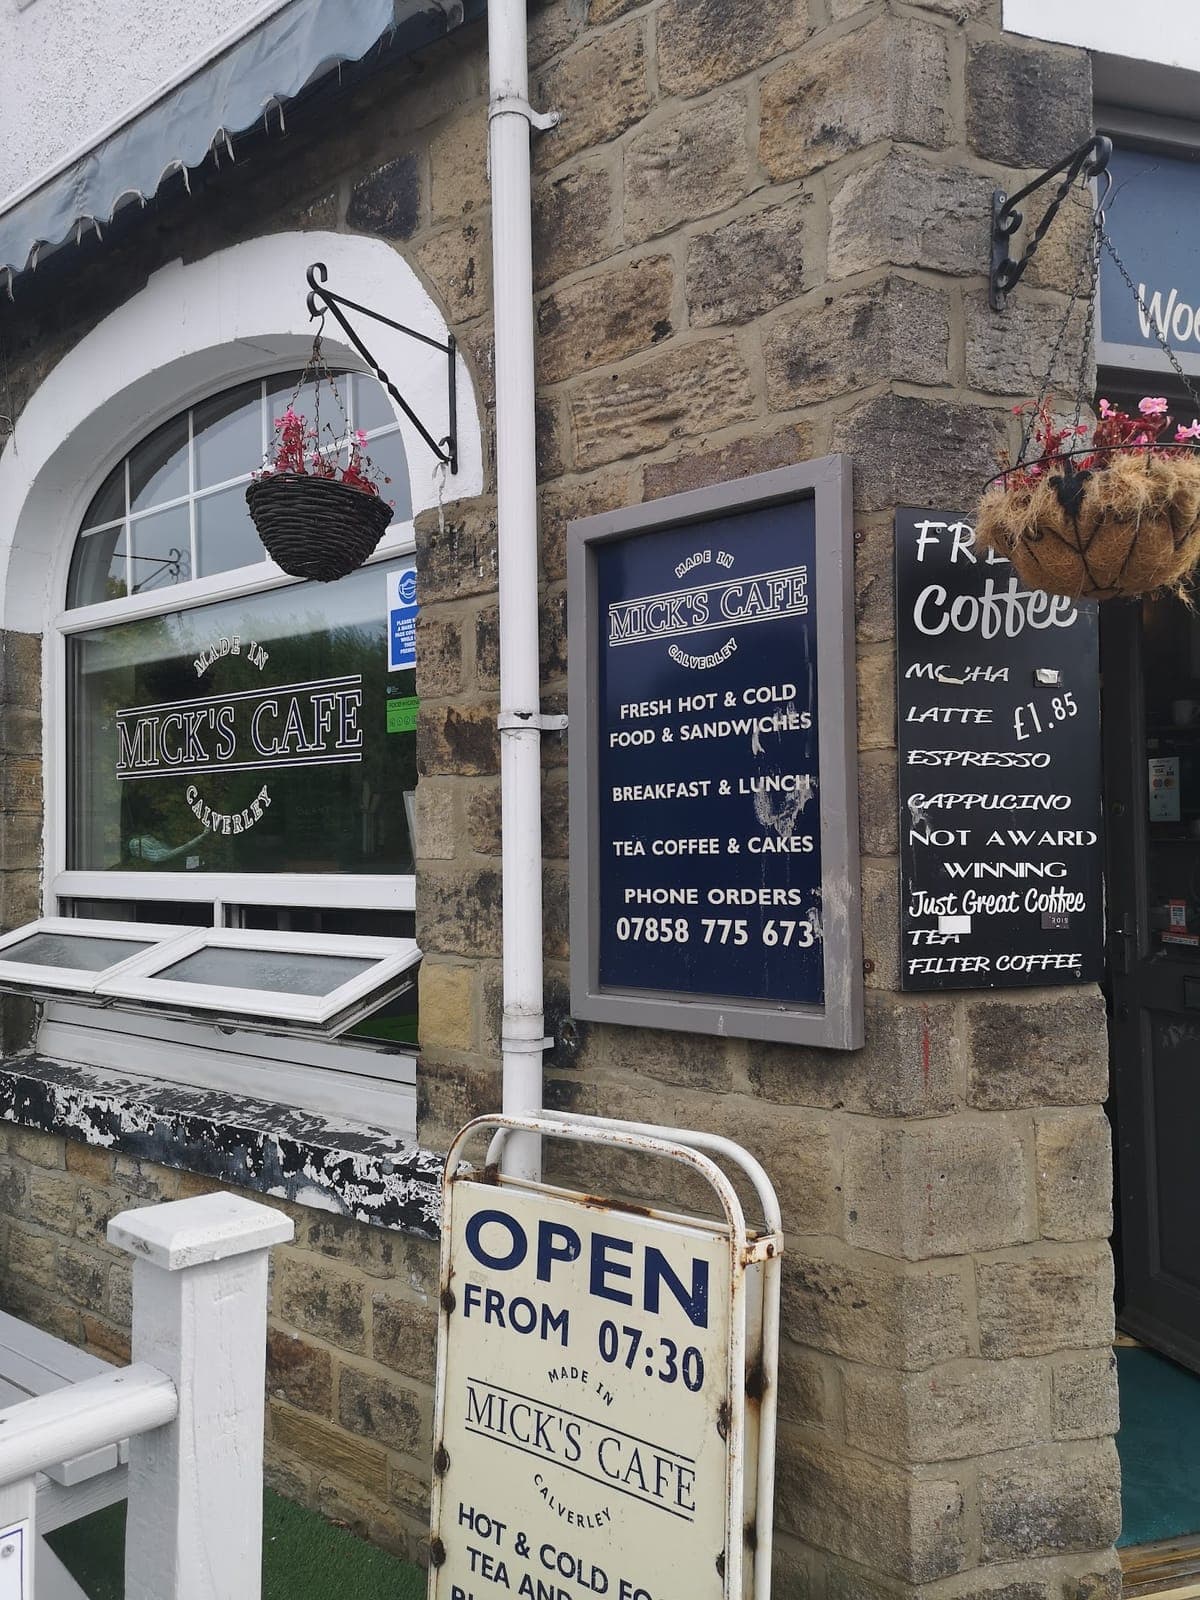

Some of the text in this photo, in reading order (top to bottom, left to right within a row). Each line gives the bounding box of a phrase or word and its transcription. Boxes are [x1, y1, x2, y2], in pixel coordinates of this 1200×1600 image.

[913, 519, 1011, 566] FR
[675, 550, 735, 578] MADE IN
[609, 574, 808, 640] MICK'S CAFE
[913, 577, 1078, 640] Coffee
[193, 636, 269, 678] MADE IN
[668, 638, 738, 669] CALVERLEY
[620, 684, 797, 720] FRESH HOT & COLD
[905, 706, 994, 724] LATTE
[1013, 691, 1078, 741] £1.85
[116, 689, 362, 769] MICK'S CAFE
[610, 712, 812, 748] FOOD & SANDWICHES
[906, 749, 1051, 768] ESPRESSO
[612, 774, 810, 802] BREAKFAST & LUNCH
[907, 793, 1072, 810] CAPPUCINO
[186, 784, 272, 835] CALVERLEY
[613, 836, 814, 856] TEA COFFEE & CAKES
[909, 829, 1097, 846] NOT AWARD
[943, 862, 1067, 878] WINNING
[624, 888, 801, 906] PHONE ORDERS
[909, 886, 1086, 917] Just Great Coffee
[616, 917, 814, 947] 07858 775 673
[907, 953, 1083, 975] FILTER COFFEE
[465, 1209, 709, 1330] OPEN
[464, 1283, 705, 1392] FROM 07:30
[548, 1366, 614, 1407] MADE IN
[465, 1386, 696, 1512] MICK'S CAFE
[534, 1473, 612, 1528] CALVERLEY
[458, 1503, 507, 1545] HOT
[514, 1531, 531, 1559] &
[539, 1543, 609, 1595] COLD
[466, 1545, 510, 1589] TEA
